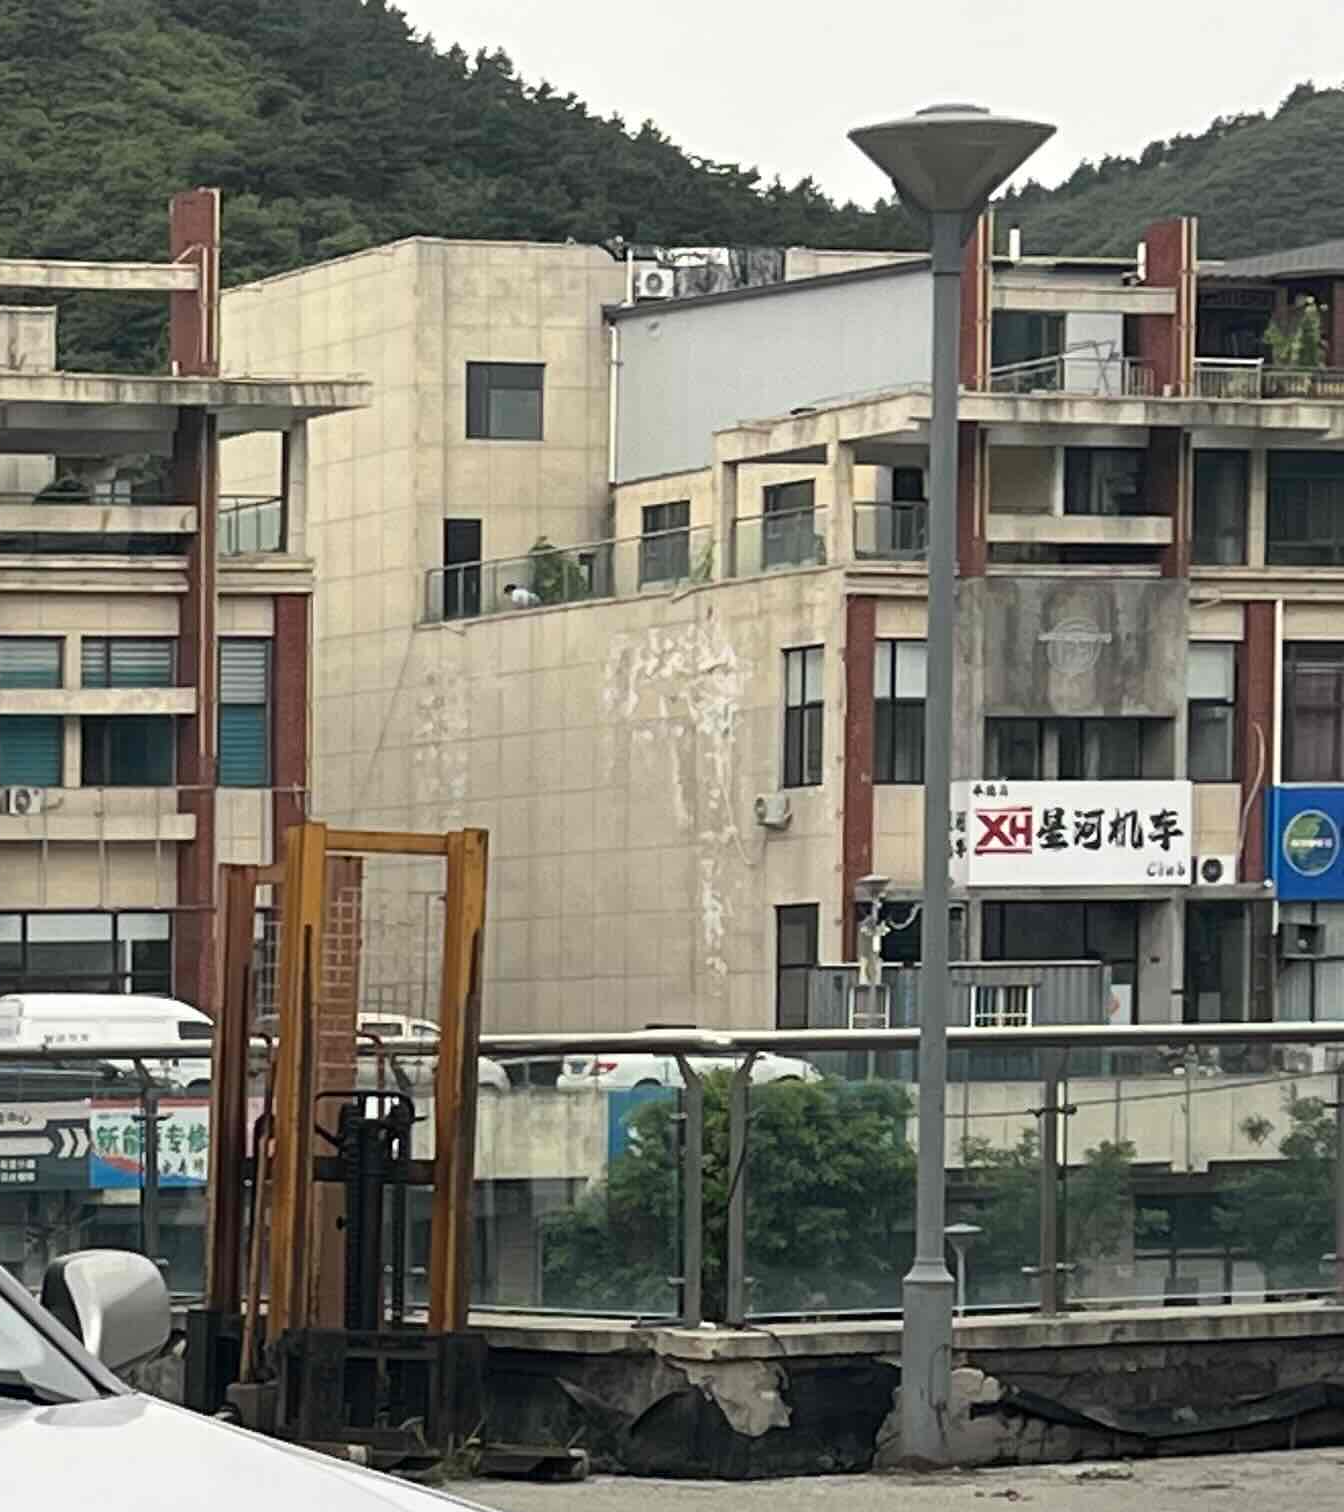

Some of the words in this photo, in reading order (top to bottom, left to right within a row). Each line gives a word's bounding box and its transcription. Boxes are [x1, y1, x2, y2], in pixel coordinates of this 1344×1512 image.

[975, 813, 1033, 848] XH
[1036, 806, 1184, 851] 星河机车
[1145, 860, 1187, 877] Club
